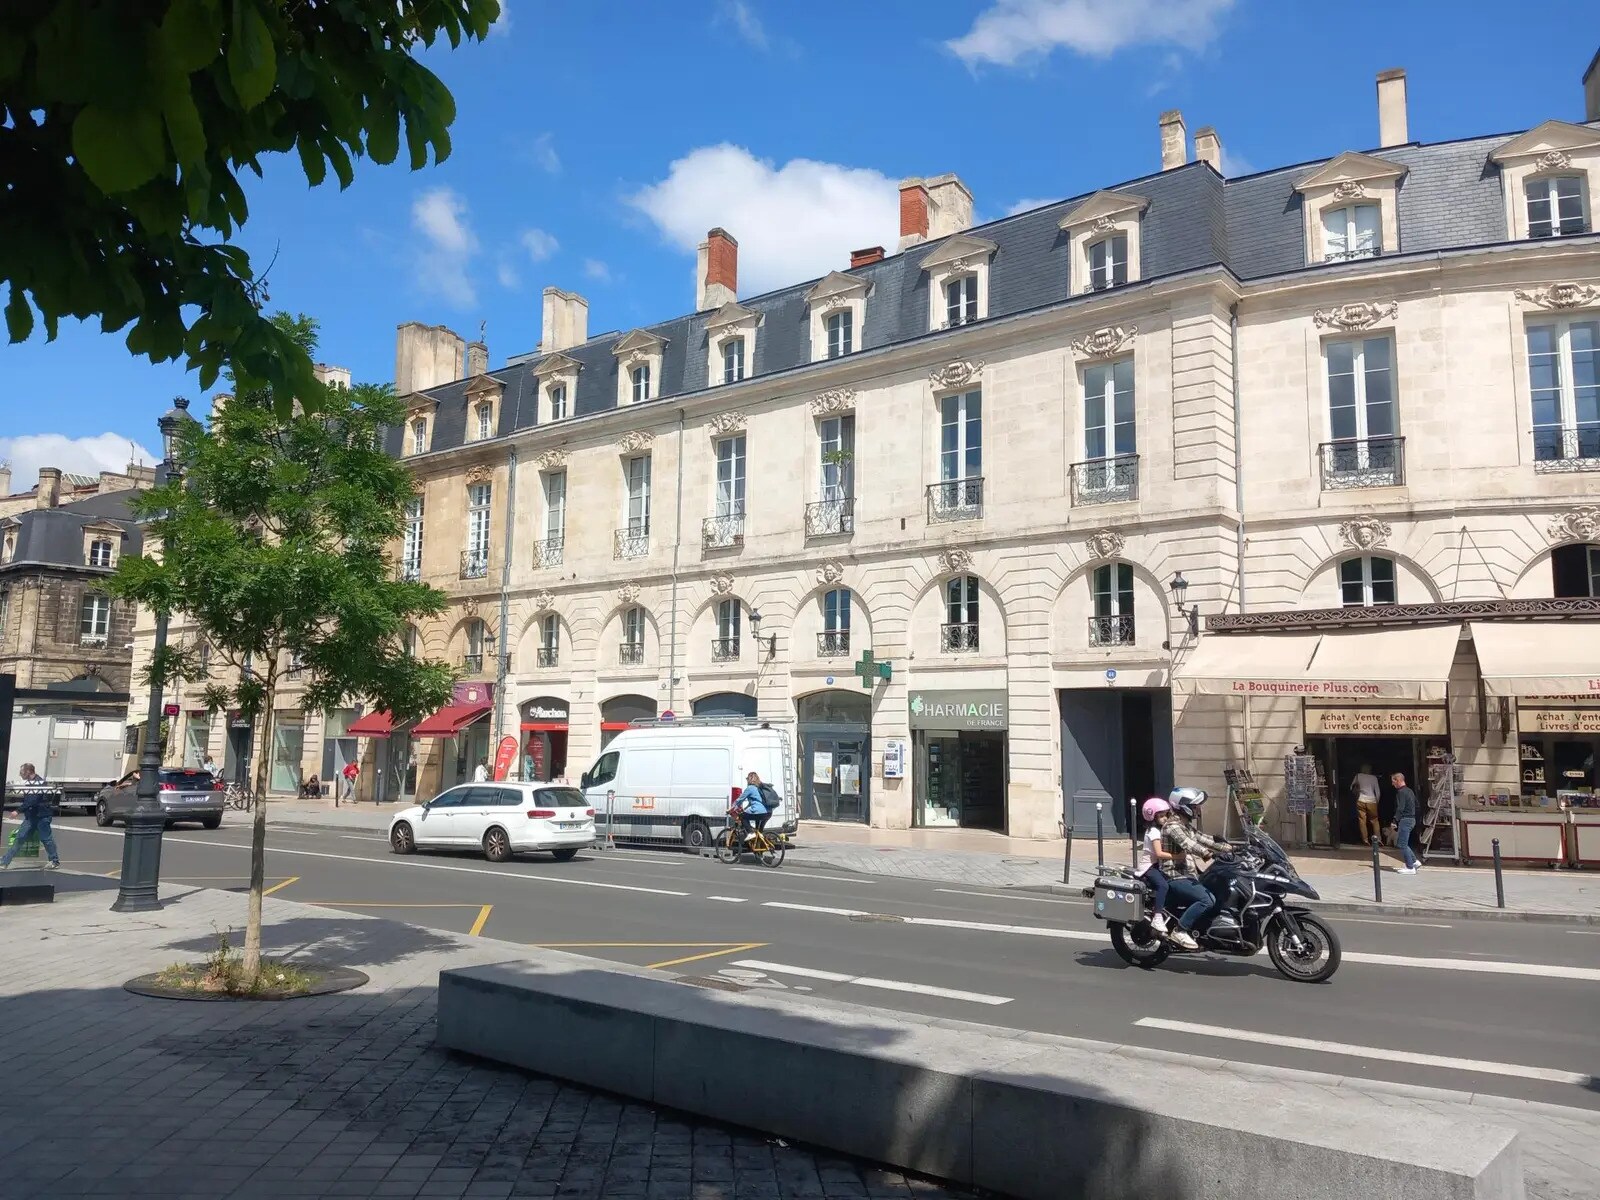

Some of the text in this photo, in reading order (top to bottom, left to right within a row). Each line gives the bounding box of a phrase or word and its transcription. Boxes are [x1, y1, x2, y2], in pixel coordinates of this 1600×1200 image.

[1232, 681, 1380, 694] La Bouquinerie Plus.com
[915, 703, 1004, 717] PHARMACIE
[1320, 713, 1346, 721] Achat
[1389, 713, 1430, 723] Echange
[1536, 713, 1565, 721] Achat
[977, 719, 1004, 727] FRANCE
[1323, 721, 1403, 730] Livres d'occasion
[1540, 722, 1570, 730] Livres
